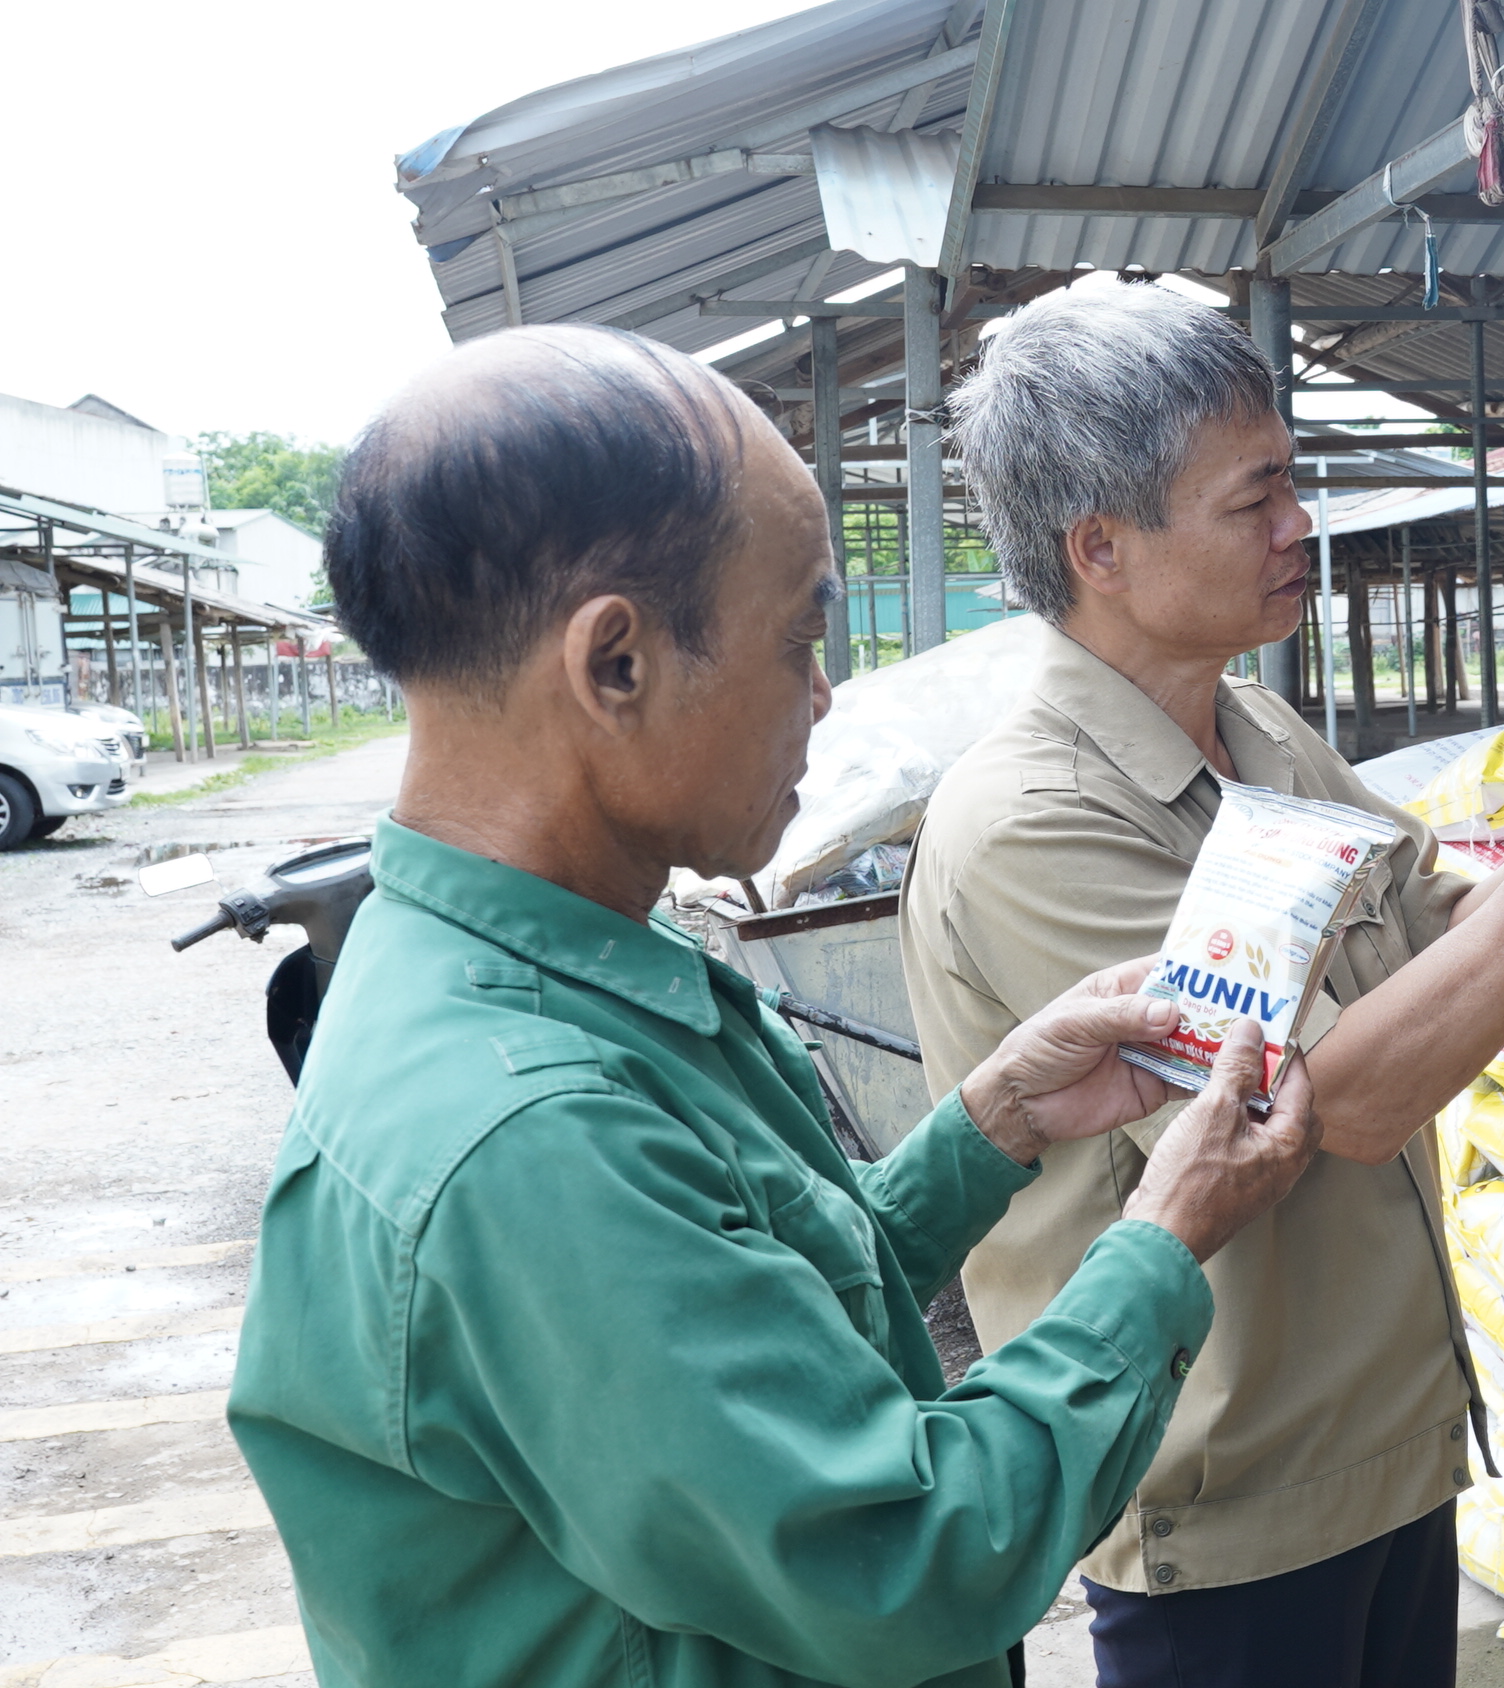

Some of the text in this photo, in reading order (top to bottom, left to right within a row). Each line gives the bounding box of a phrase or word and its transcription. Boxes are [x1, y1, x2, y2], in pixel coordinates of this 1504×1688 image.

[1313, 856, 1350, 880] COMPANY
[1151, 957, 1290, 1023] MUNIV
[1183, 997, 1217, 1017] Dạng bột
